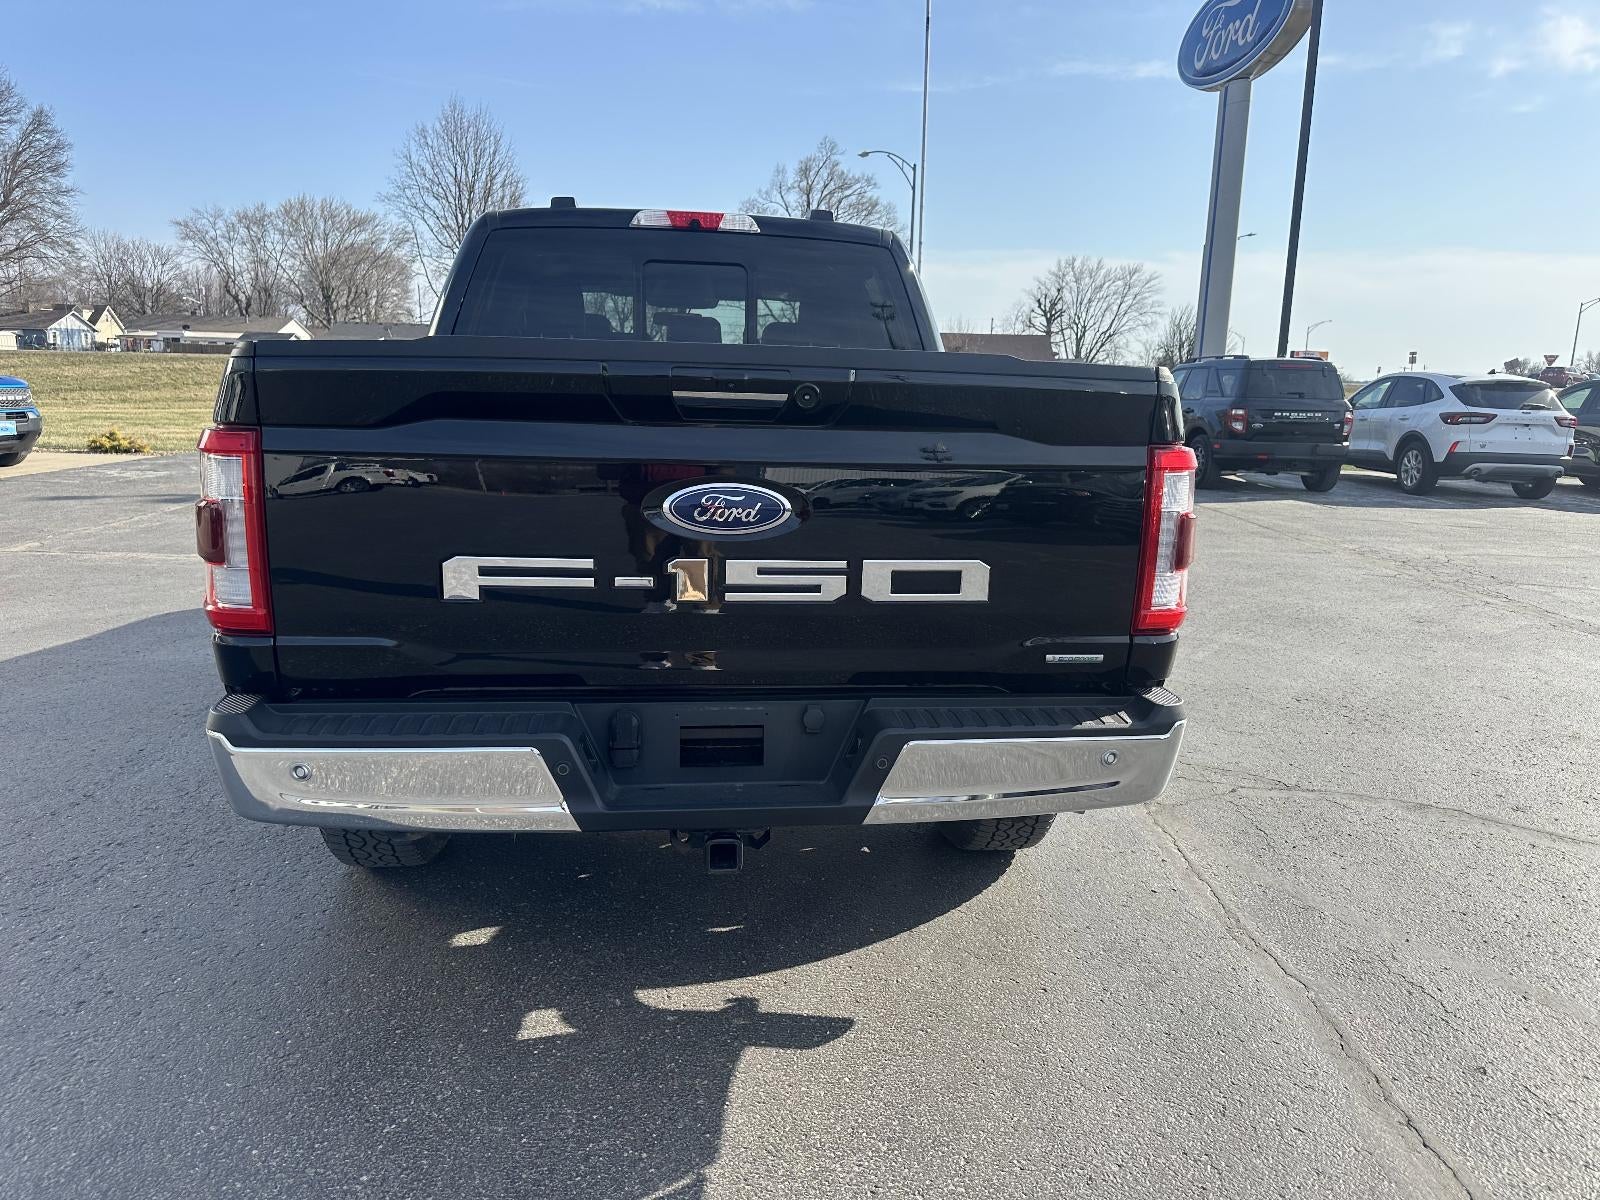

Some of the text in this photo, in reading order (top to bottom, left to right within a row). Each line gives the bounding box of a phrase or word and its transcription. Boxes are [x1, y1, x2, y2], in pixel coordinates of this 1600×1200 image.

[1194, 0, 1262, 71] Ford
[693, 493, 762, 522] Ford
[442, 556, 991, 602] F-150
